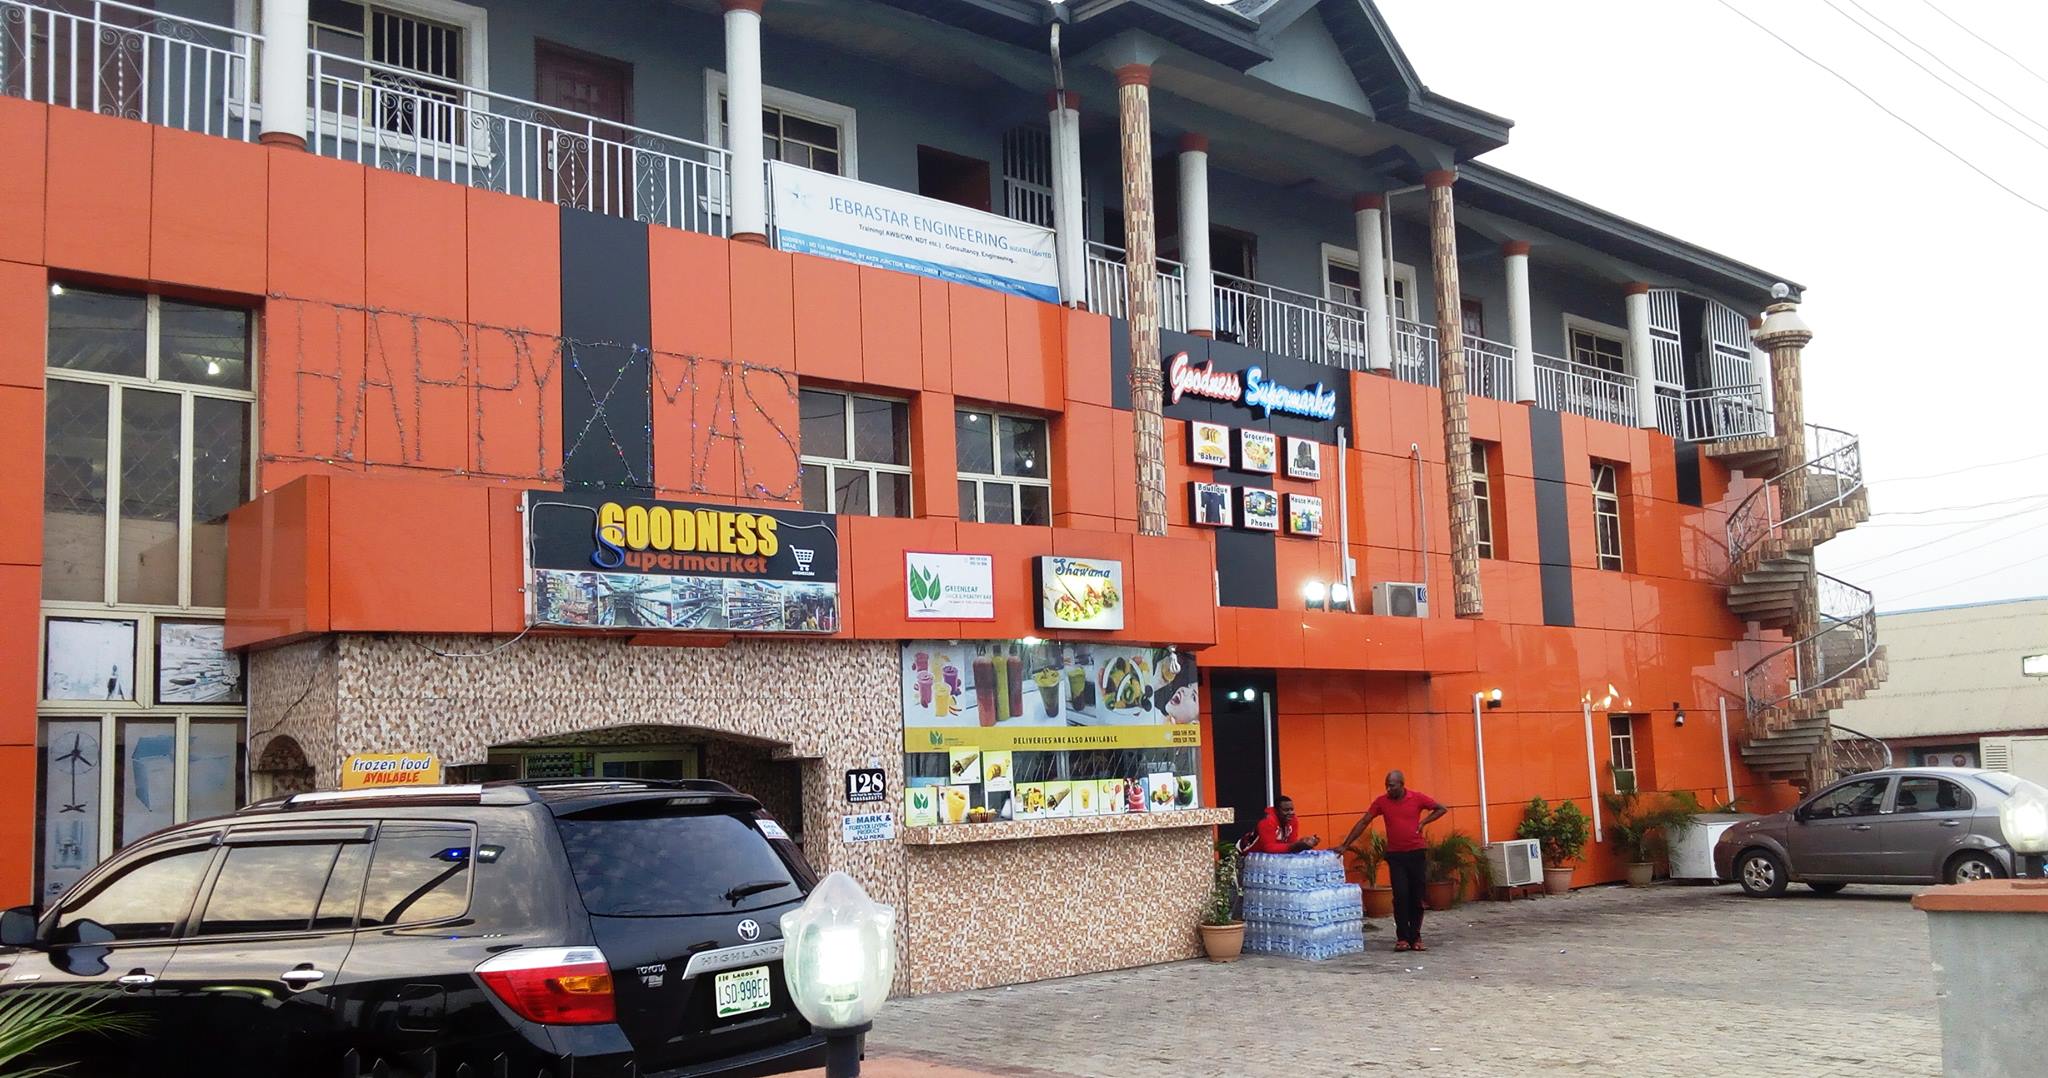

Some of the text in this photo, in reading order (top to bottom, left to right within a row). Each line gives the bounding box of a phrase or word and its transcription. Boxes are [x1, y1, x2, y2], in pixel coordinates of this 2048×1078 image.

[829, 196, 910, 229] JEBRASTAR
[914, 216, 1009, 250] ENGINEERING
[296, 298, 563, 478] HAPPY
[1169, 352, 1336, 420] Goodness Supermarket
[1243, 431, 1274, 443] Groceries
[1199, 452, 1224, 463] Bakery
[1289, 467, 1320, 479] Electronics
[1197, 484, 1228, 494] Boutique
[1250, 518, 1273, 528] Phones
[599, 502, 779, 557] GOODNESS
[590, 524, 768, 574] Supermarket
[1053, 558, 1111, 579] Shawama
[944, 585, 978, 593] GREENLEAF
[1013, 735, 1119, 745] DELIVERIES ARE ALSO AVAILABLE
[352, 756, 431, 771] frozen food
[363, 771, 421, 784] AVAILABLE
[848, 772, 884, 794] 128
[856, 815, 883, 824] MARK
[884, 814, 892, 822] &
[636, 963, 667, 975] TOYOTA
